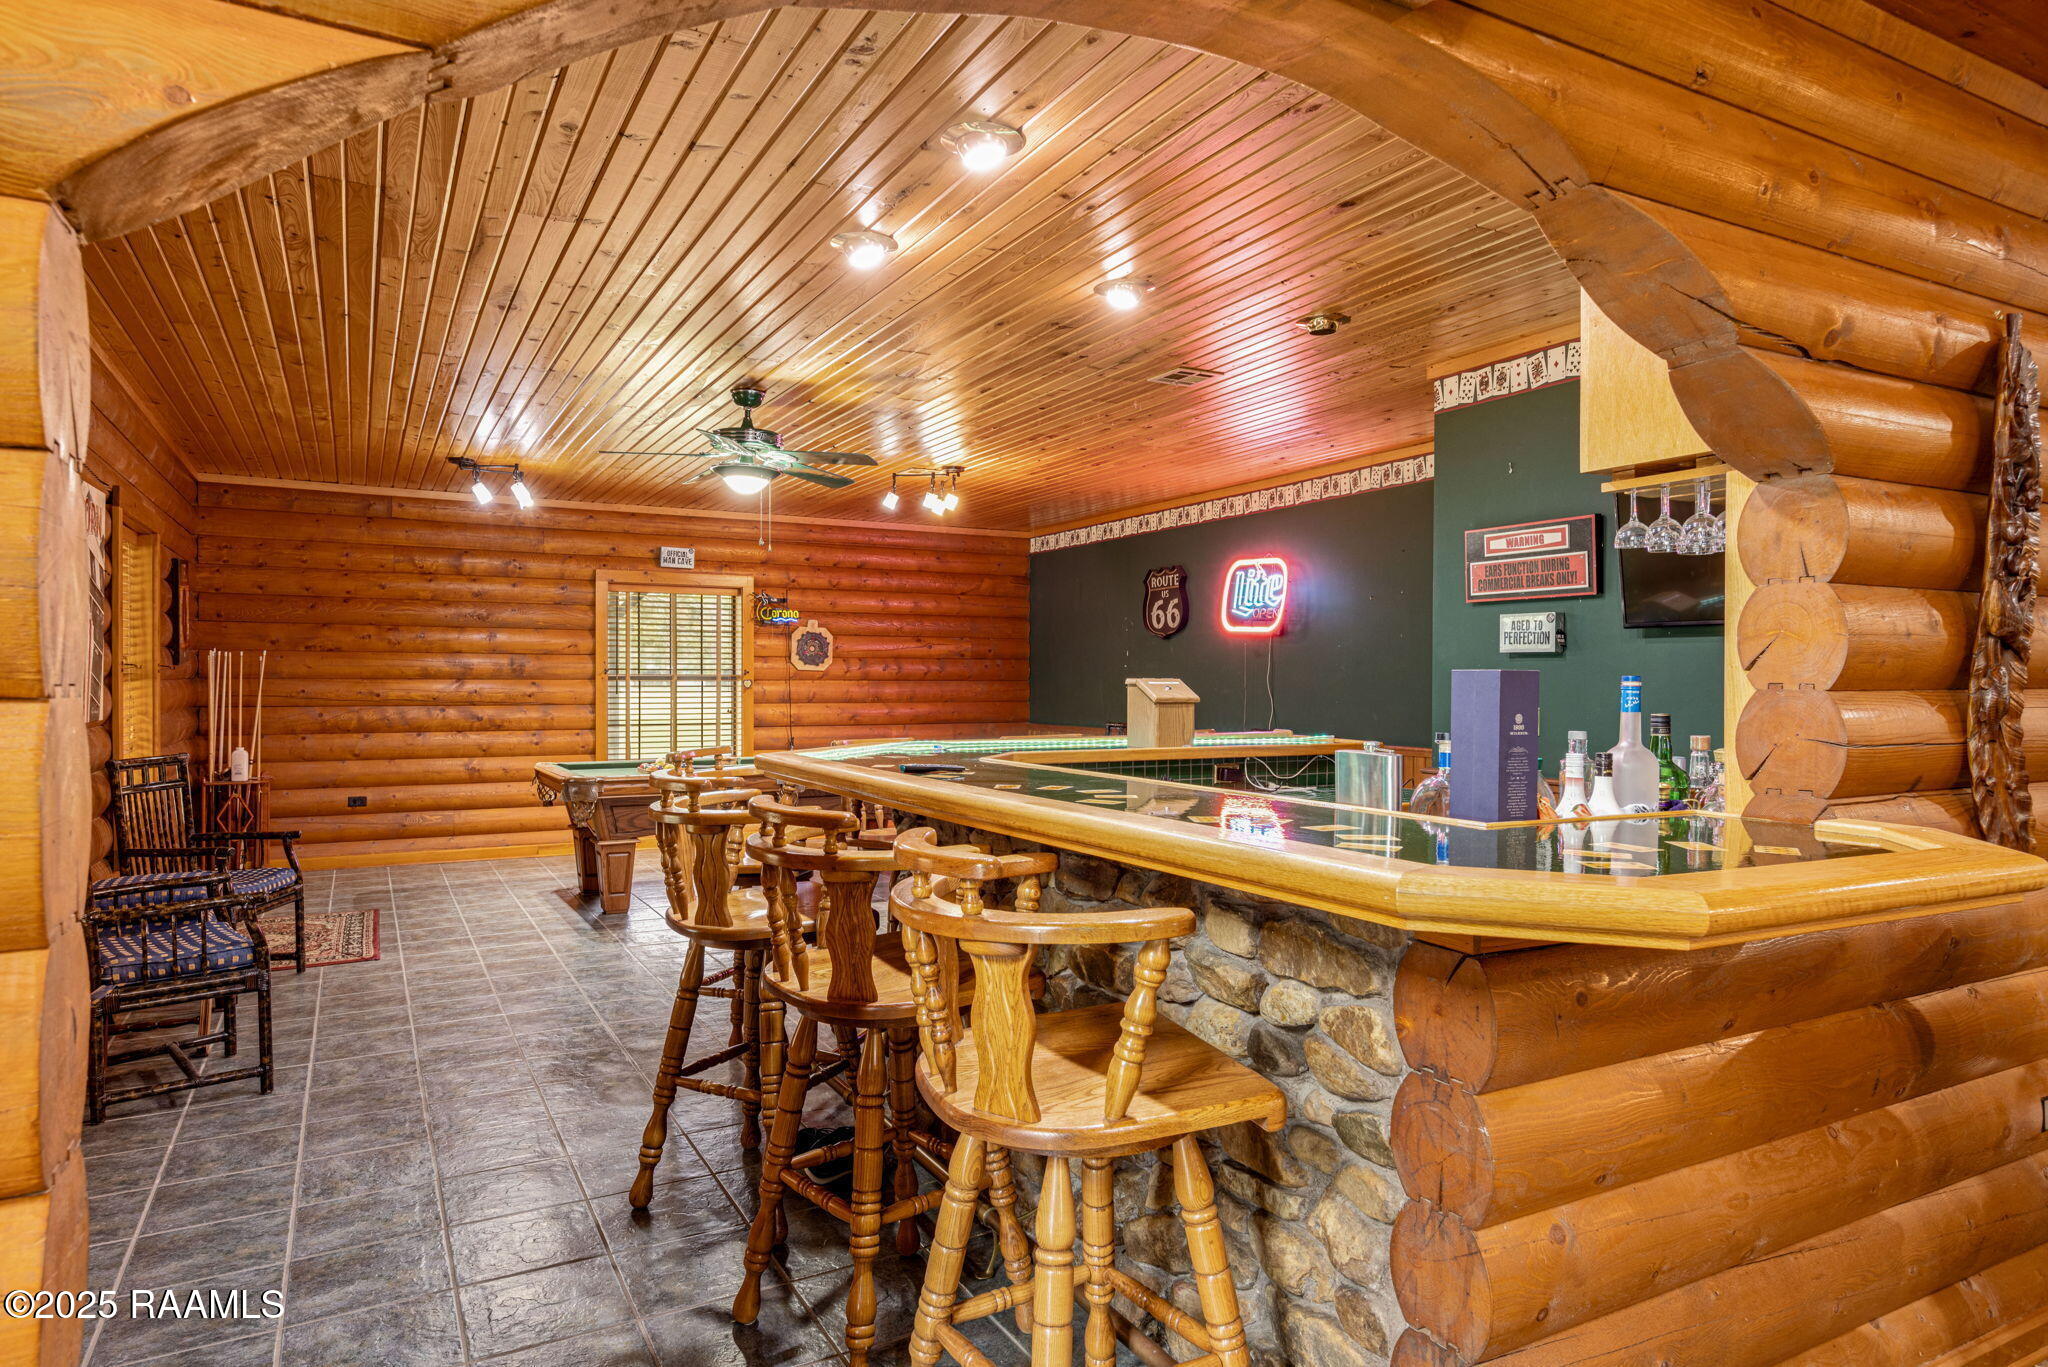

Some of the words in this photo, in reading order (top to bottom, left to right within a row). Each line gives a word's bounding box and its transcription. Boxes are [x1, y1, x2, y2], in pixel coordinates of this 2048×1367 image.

[1505, 534, 1545, 549] WARNING
[666, 550, 689, 558] OFFICIAL
[662, 556, 676, 564] MAN
[677, 557, 693, 566] CAVE
[1484, 562, 1503, 577] EARS
[1504, 559, 1539, 576] FUNCTION
[1540, 557, 1570, 573] DURING
[1150, 574, 1179, 587] ROUTE
[1478, 576, 1525, 592] COMMERCIAL
[1526, 573, 1555, 588] BREAKS
[1556, 571, 1578, 585] ONLY!
[1161, 590, 1169, 598] US
[760, 606, 799, 620] Corona
[1150, 598, 1181, 629] 66
[1253, 608, 1281, 619] OPEN
[1510, 620, 1531, 632] AGED
[1533, 620, 1543, 631] TO
[1503, 631, 1551, 645] PERFECTION
